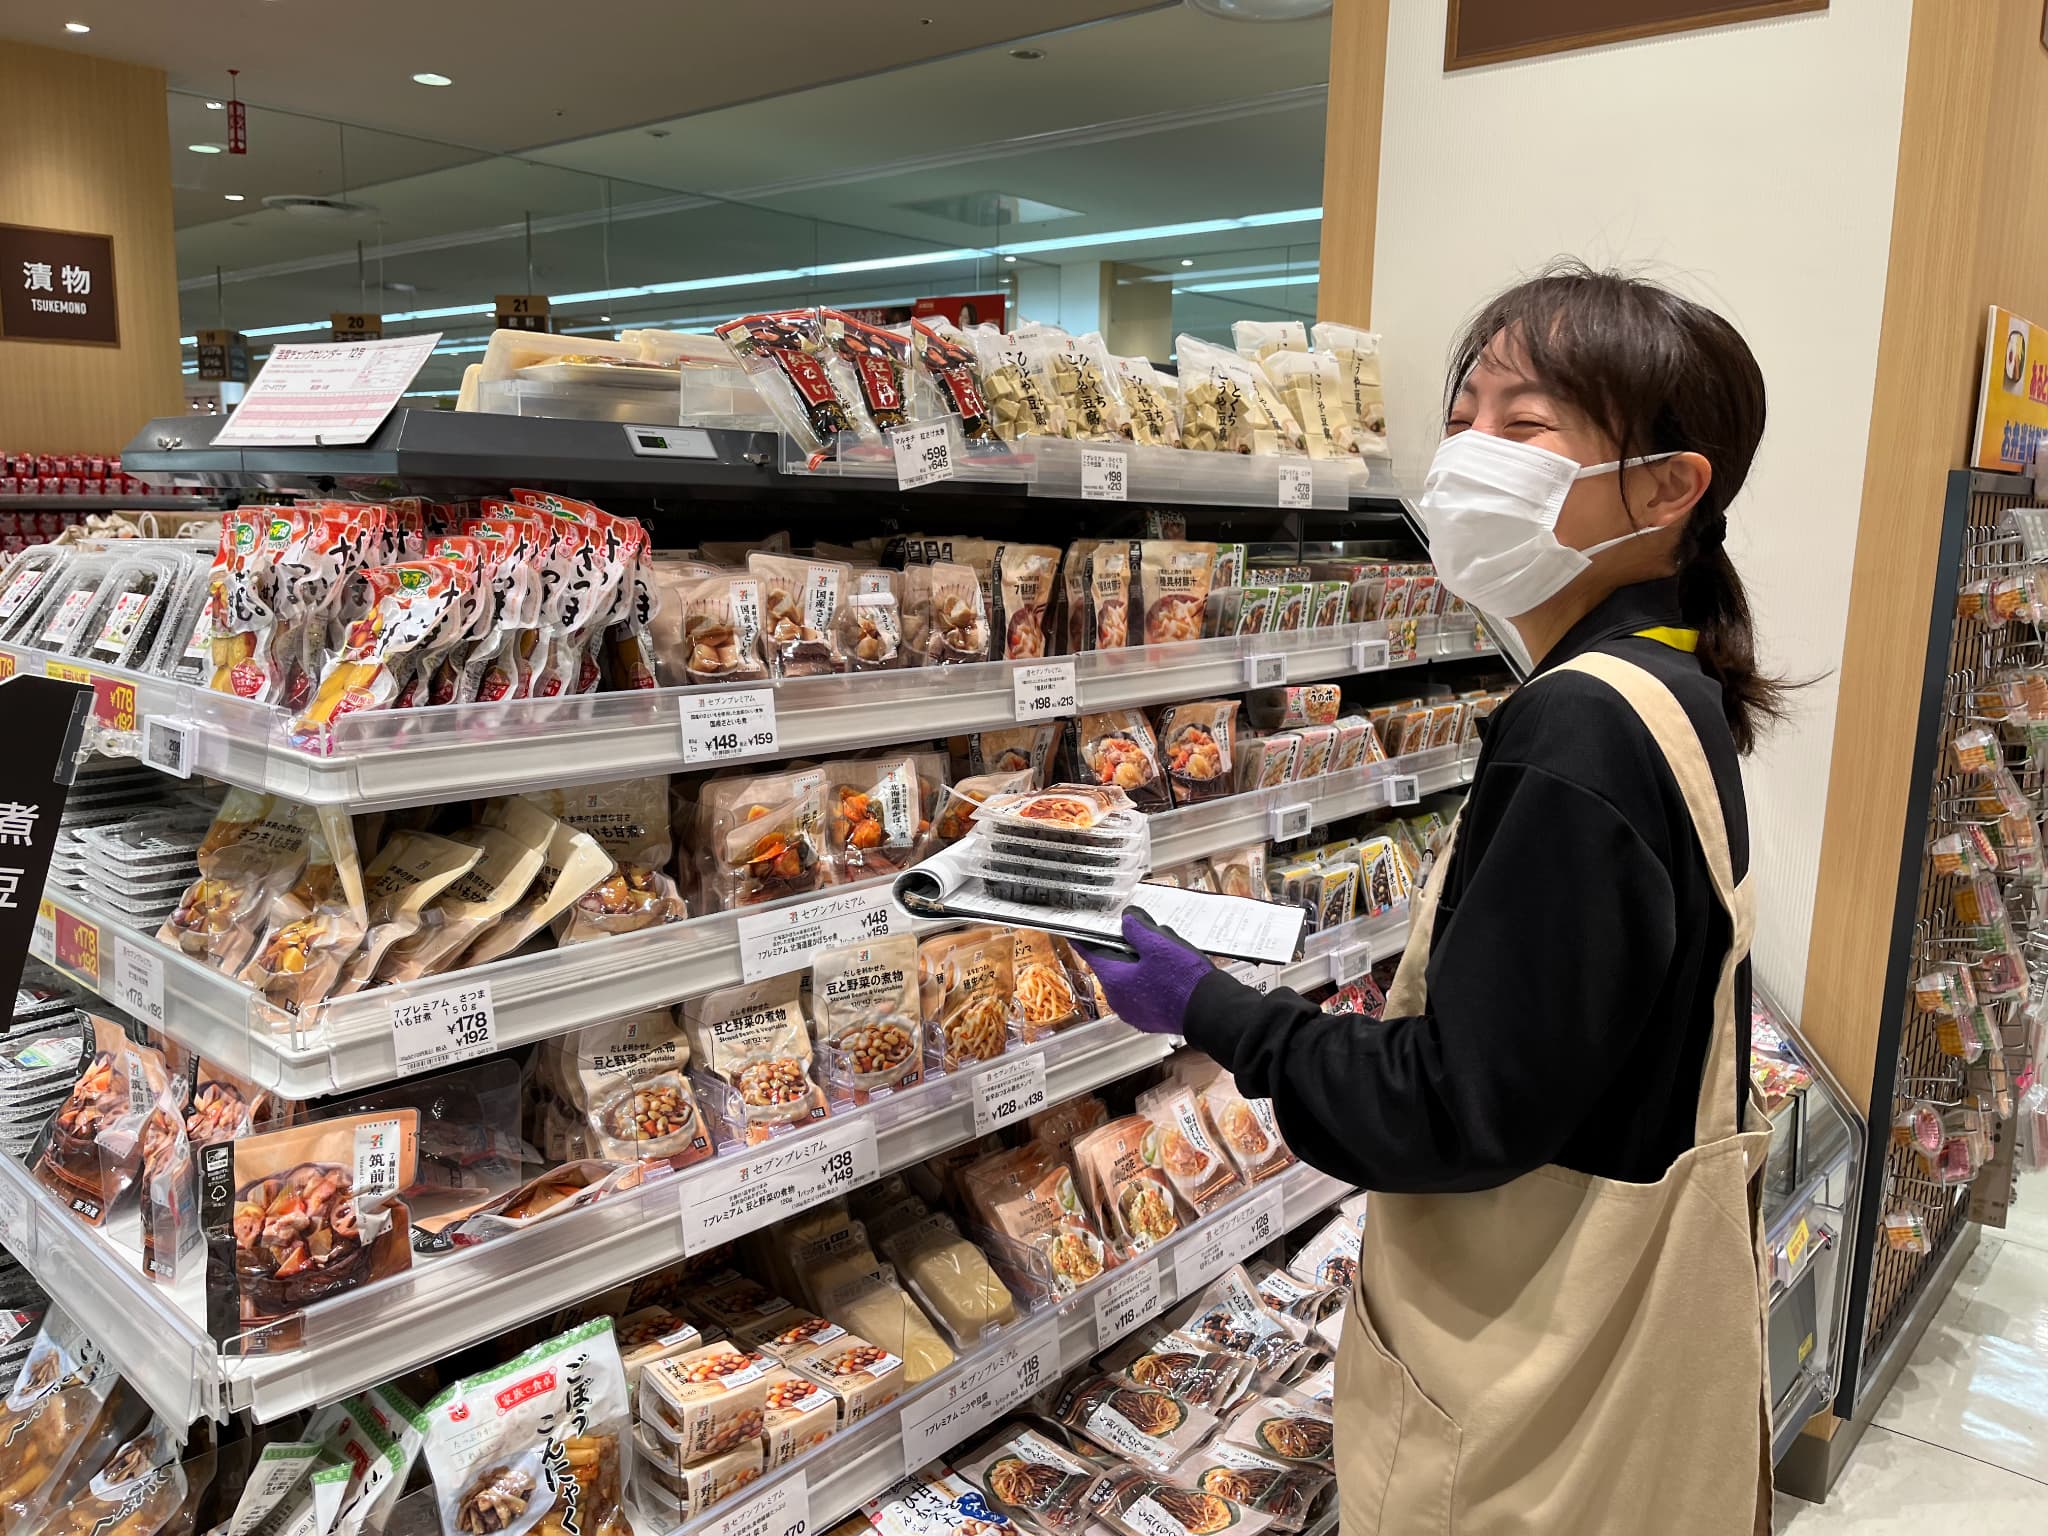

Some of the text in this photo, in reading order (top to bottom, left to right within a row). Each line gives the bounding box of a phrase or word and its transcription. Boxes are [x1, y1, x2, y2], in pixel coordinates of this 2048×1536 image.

[23, 262, 91, 294] 漬物
[31, 299, 87, 315] TSUKEMONO
[513, 299, 528, 312] 21
[348, 316, 364, 329] 20
[922, 445, 947, 462] ¥598
[928, 457, 948, 471] ¥645
[1104, 471, 1122, 482] ¥198
[1107, 482, 1122, 491] ¥213
[110, 686, 134, 713] ¥178
[708, 695, 756, 706] セブンプレミアム
[1029, 696, 1074, 710] ¥198 ¥213
[1310, 689, 1335, 703] うの花
[113, 711, 134, 731] ¥192
[704, 732, 773, 751] ¥148 ¥159
[0, 801, 40, 909] 煮豆
[801, 896, 867, 920] セブンプレミアム
[860, 909, 888, 928] ¥148
[74, 926, 97, 955] ¥178
[866, 926, 889, 938] ¥159
[78, 950, 97, 976] ¥192
[825, 970, 904, 996] 豆と野菜の煮物
[126, 987, 143, 1008] ¥178
[394, 989, 485, 1018] 7プレミアム さつま
[394, 1012, 432, 1029] いも甘煮
[447, 1012, 487, 1034] ¥178
[712, 1007, 787, 1036] 豆と野菜の煮物
[456, 1028, 488, 1046] ¥192
[992, 1090, 1044, 1120] ¥128 ¥138
[753, 1140, 827, 1176] セブンプレミアム
[821, 1150, 853, 1175] ¥138
[827, 1167, 854, 1187] ¥149
[72, 1199, 100, 1220] 要冷蔵
[703, 1208, 743, 1228] 7プレミアム
[745, 1184, 796, 1213] 豆と野菜の煮物
[1251, 1213, 1269, 1233] ¥128
[1255, 1225, 1270, 1242] ¥138
[1114, 1295, 1158, 1331] ¥118 ¥127
[959, 1350, 1019, 1391] セブンプレミアム
[1016, 1354, 1040, 1379] ¥118
[1019, 1369, 1040, 1391] ¥127
[565, 1353, 593, 1438] ごぼう
[925, 1411, 959, 1438] 7プレミアム
[960, 1391, 989, 1414] こうや豆腐
[537, 1413, 580, 1535] こんにゃく
[731, 1489, 785, 1526] セブンプレミアム
